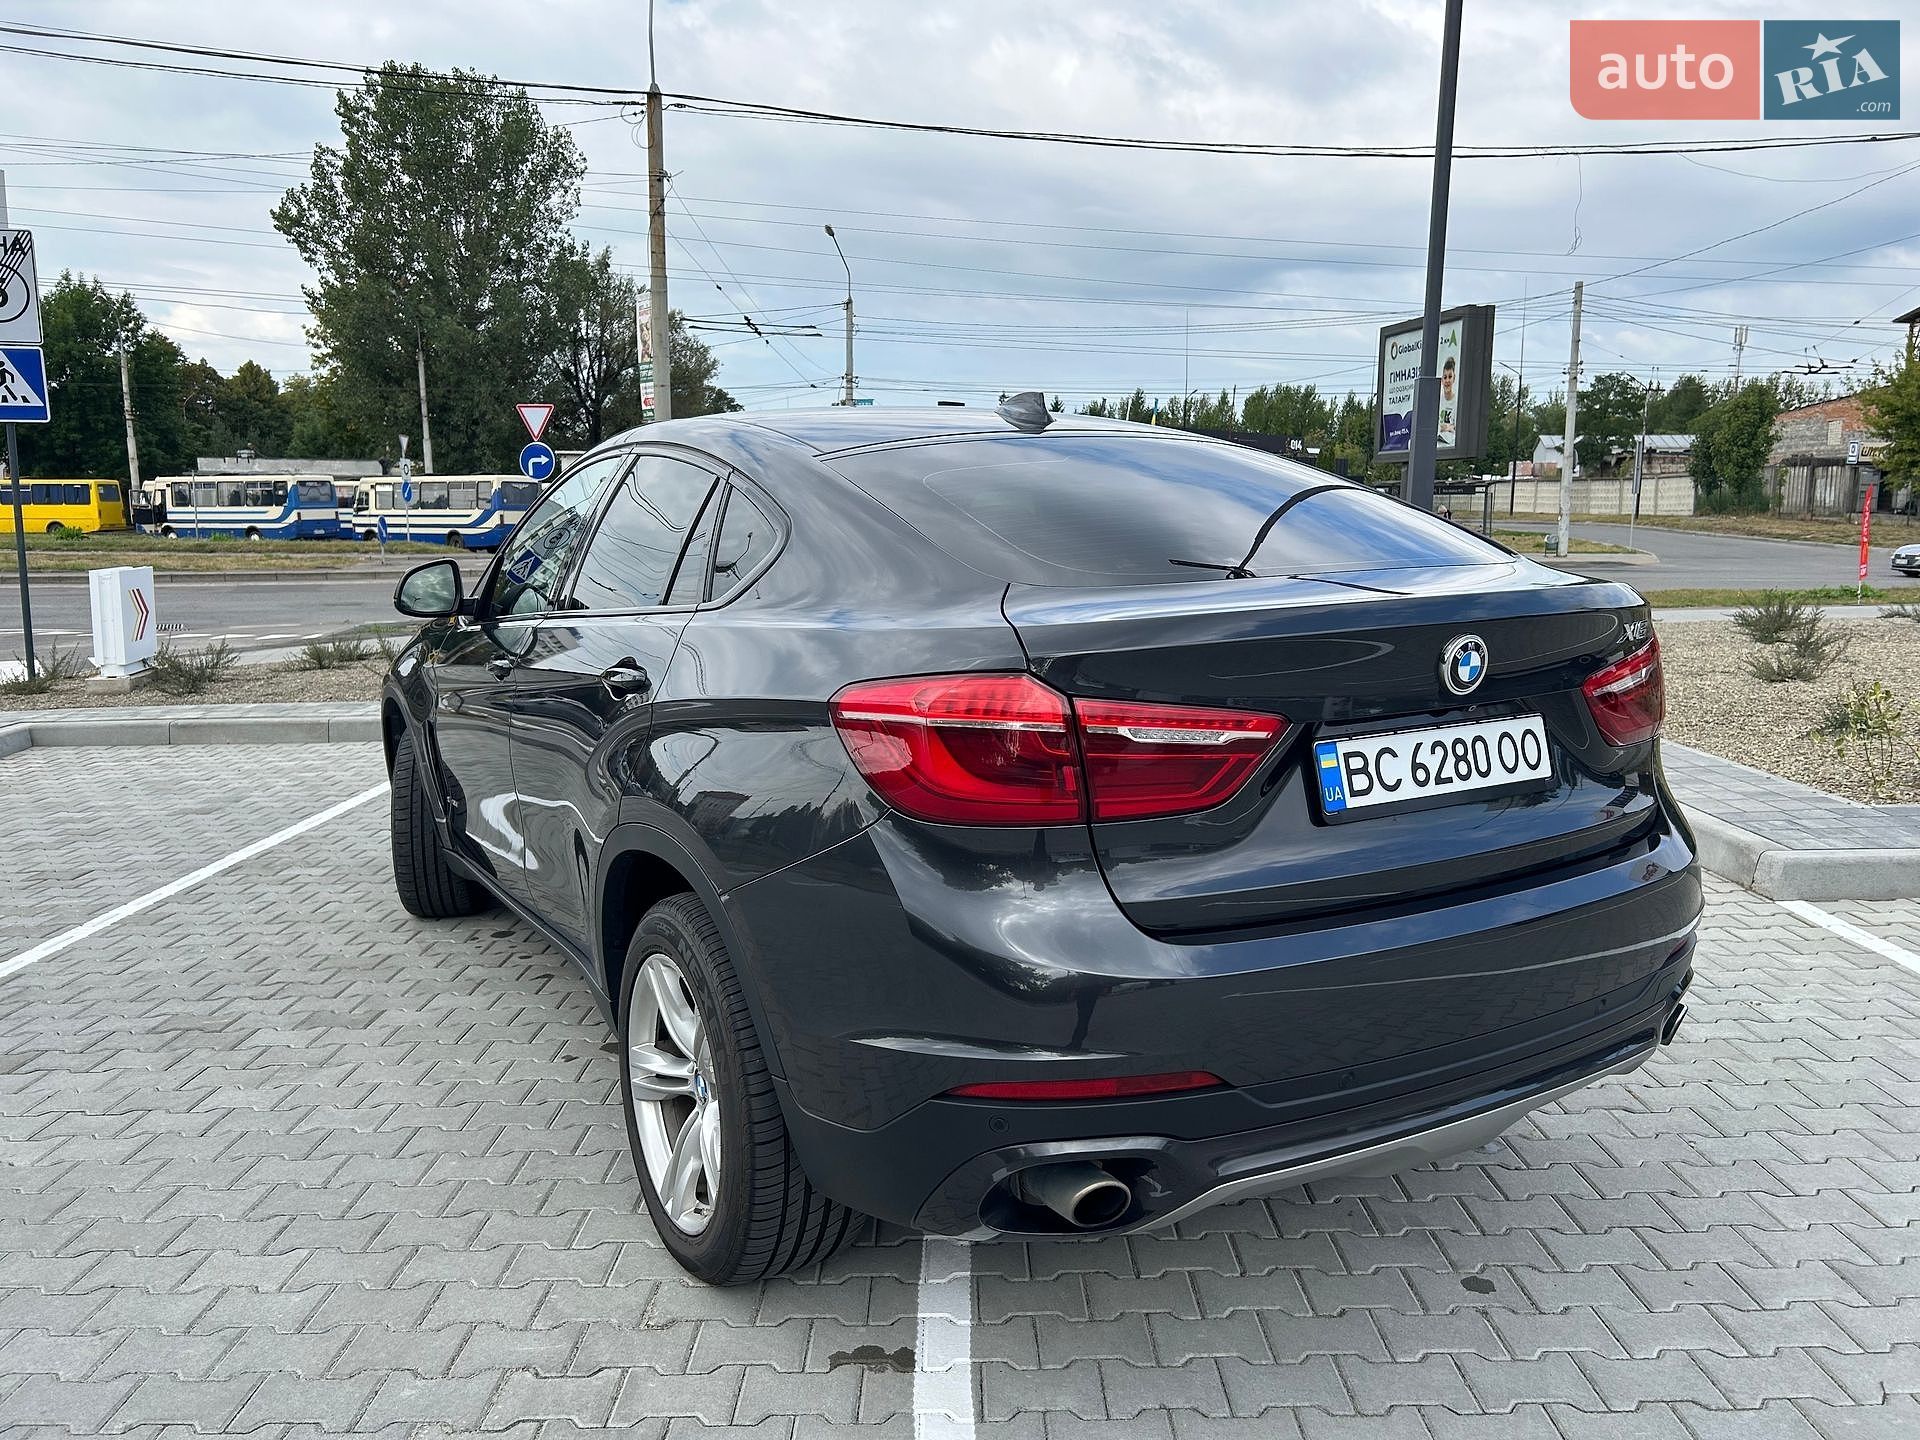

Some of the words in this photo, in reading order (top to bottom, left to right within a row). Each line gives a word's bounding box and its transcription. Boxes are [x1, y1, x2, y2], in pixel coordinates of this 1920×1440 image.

[1398, 339, 1423, 354] GlobalKi
[1343, 748, 1403, 798] BC
[1411, 734, 1492, 788] 6280
[1325, 785, 1343, 803] UA
